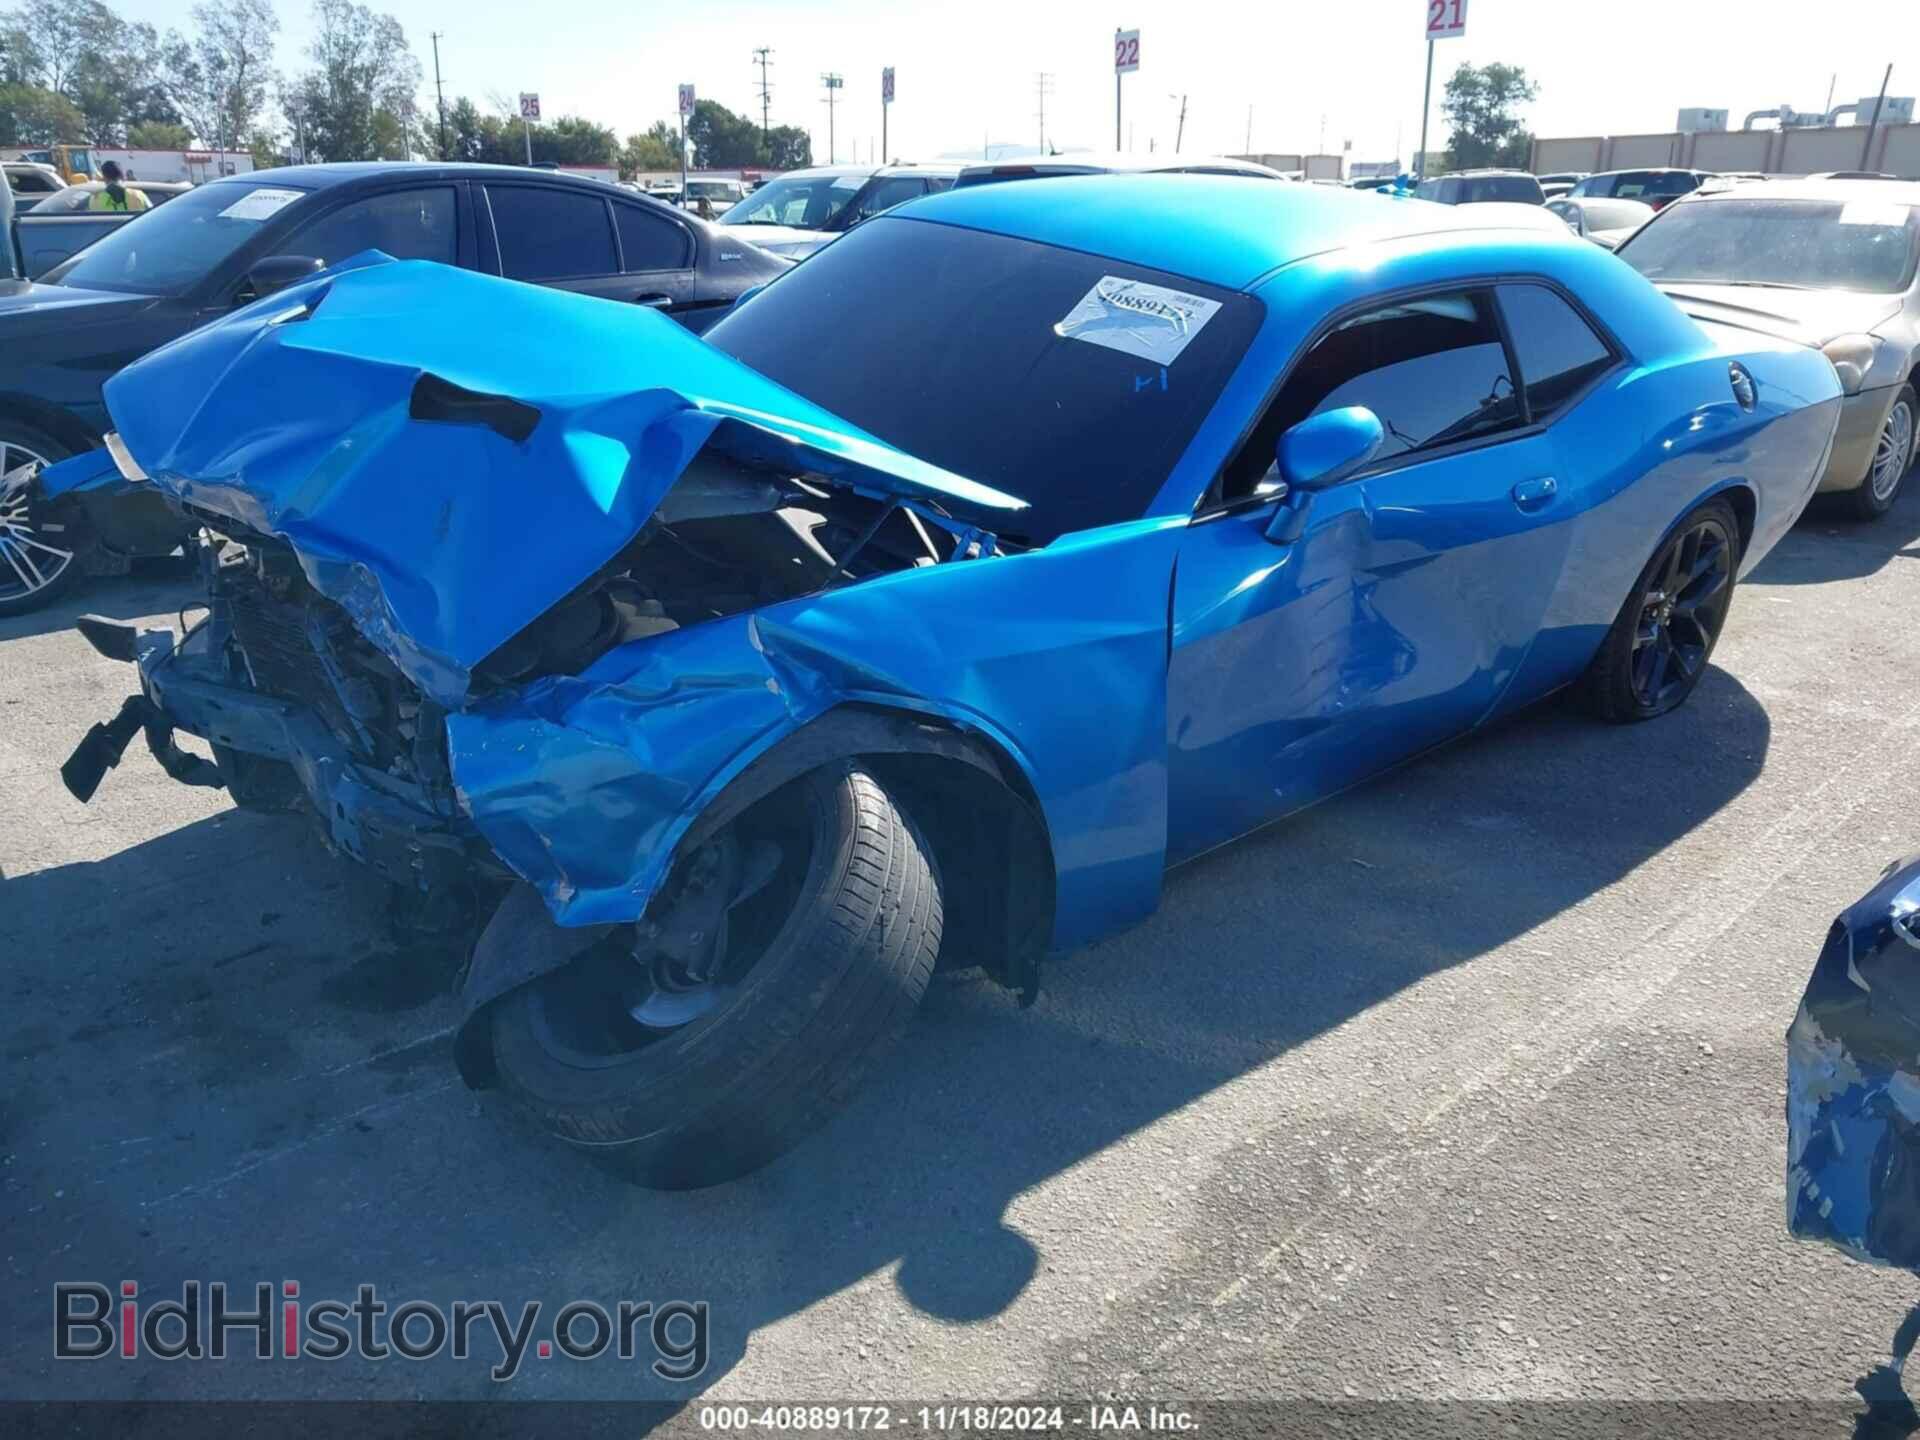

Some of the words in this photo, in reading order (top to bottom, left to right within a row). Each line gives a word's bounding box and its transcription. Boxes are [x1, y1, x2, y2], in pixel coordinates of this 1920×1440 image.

[1428, 0, 1464, 31] 21
[1116, 38, 1139, 67] 22
[883, 75, 895, 97] 23
[521, 98, 540, 117] 25
[679, 90, 693, 111] 24
